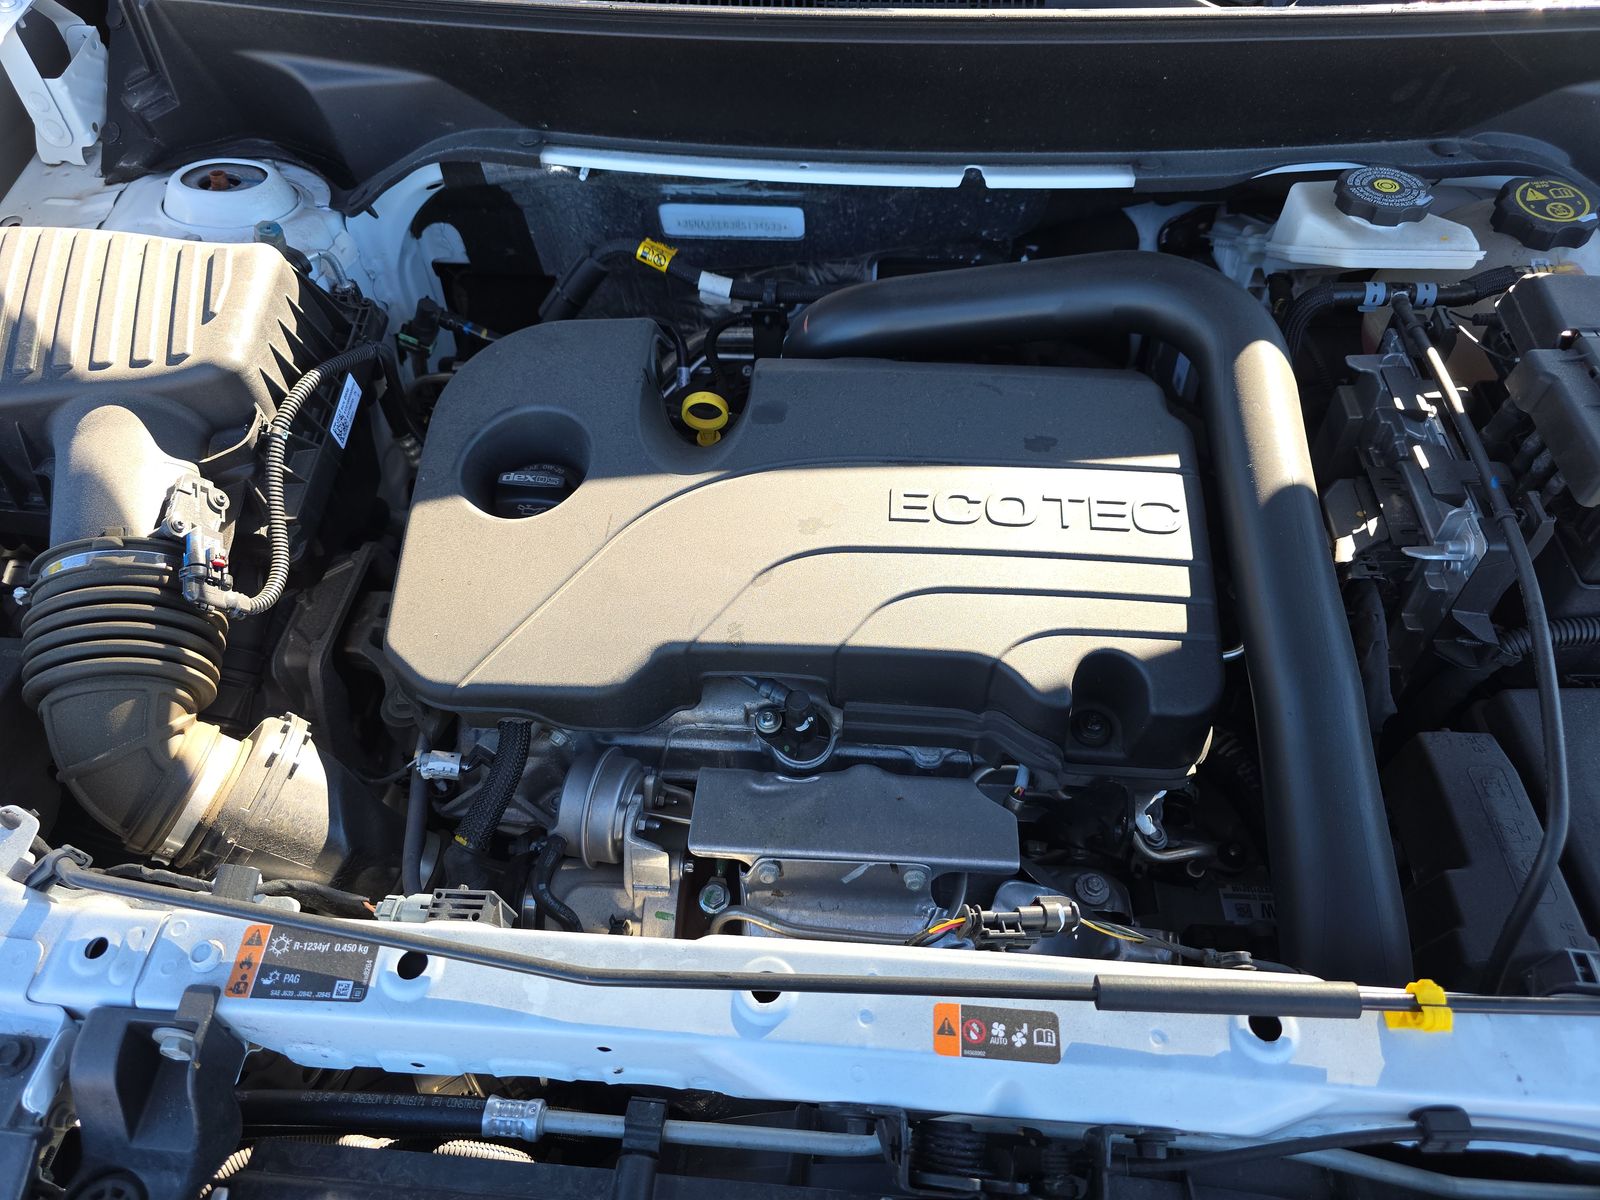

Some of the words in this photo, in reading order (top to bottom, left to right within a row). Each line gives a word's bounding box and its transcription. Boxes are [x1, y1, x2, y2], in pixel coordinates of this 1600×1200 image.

[502, 472, 559, 486] dexos
[888, 488, 1182, 535] ECOTEC
[293, 941, 331, 952] R-1234yf
[334, 943, 357, 952] 0.450
[357, 944, 369, 955] kg
[283, 973, 301, 984] PAG
[989, 1036, 1008, 1045] AUTO
